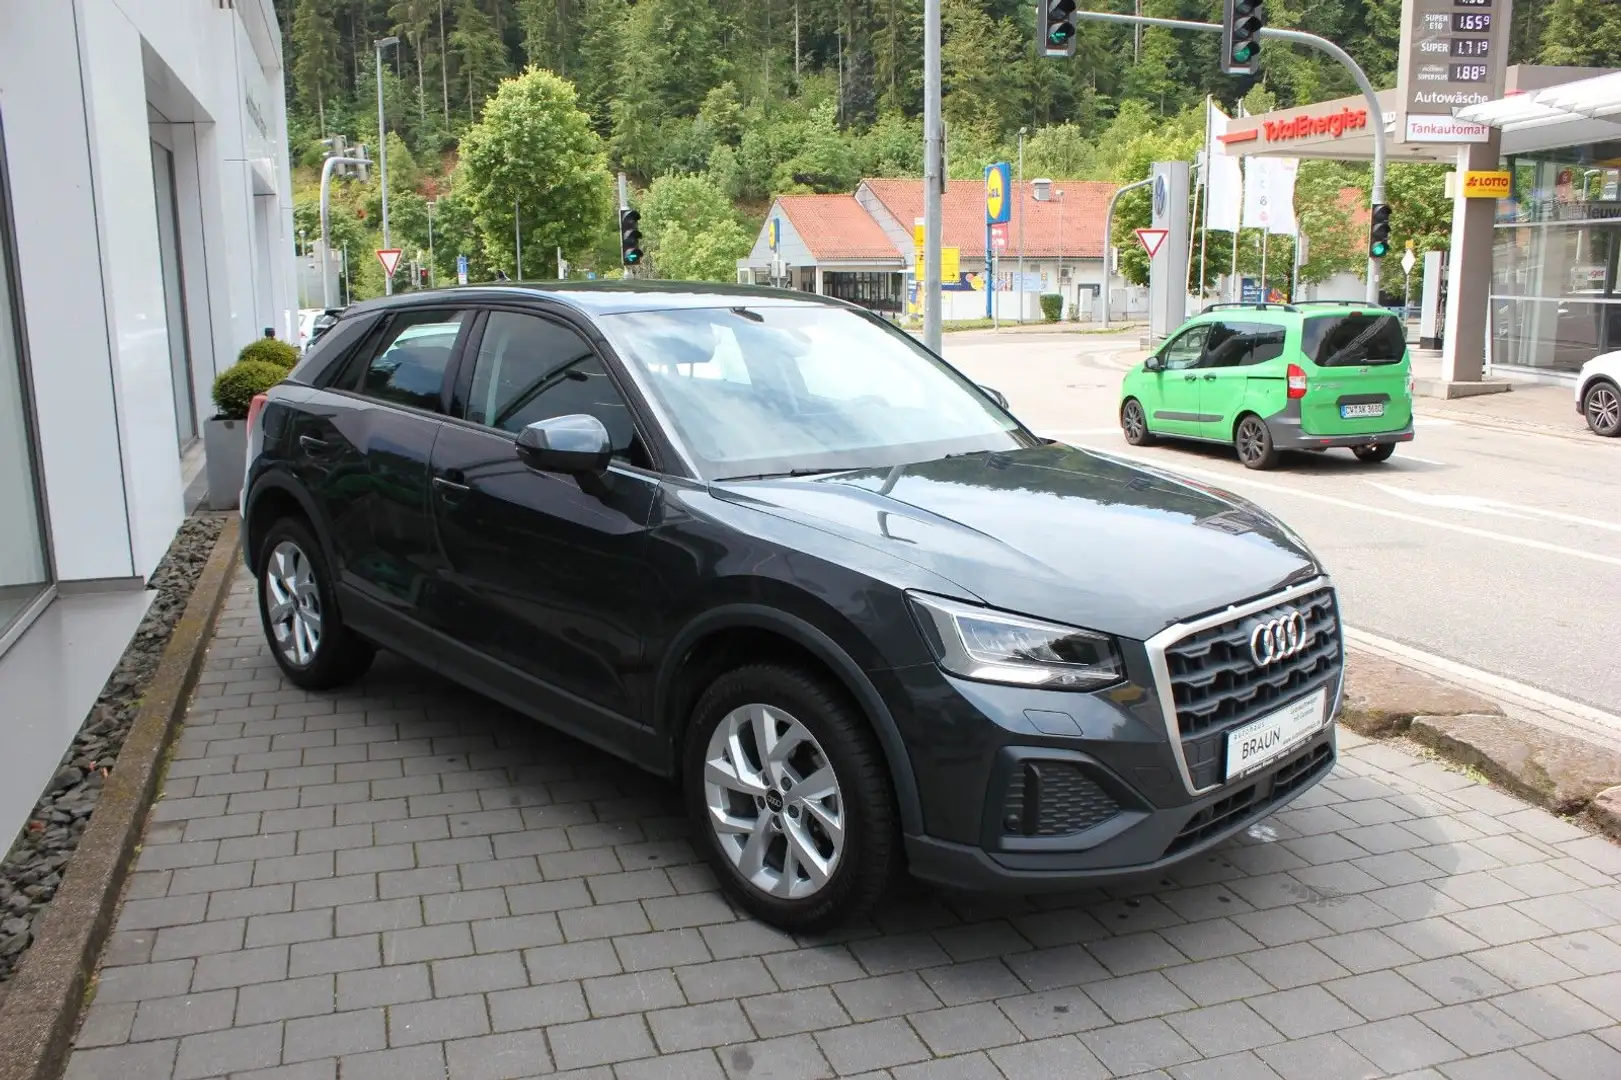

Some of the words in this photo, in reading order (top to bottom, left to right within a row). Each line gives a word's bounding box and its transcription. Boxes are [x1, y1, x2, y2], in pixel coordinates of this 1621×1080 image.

[1425, 14, 1449, 22] SUPER
[1429, 22, 1443, 30] E10
[1421, 42, 1449, 53] SUPER
[1414, 91, 1489, 104] Autowäsche
[1263, 107, 1367, 143] TotalEnergies
[1410, 122, 1486, 136] Tankautomat
[1479, 177, 1508, 187] LOTTO
[1242, 725, 1280, 760] BRAUN
